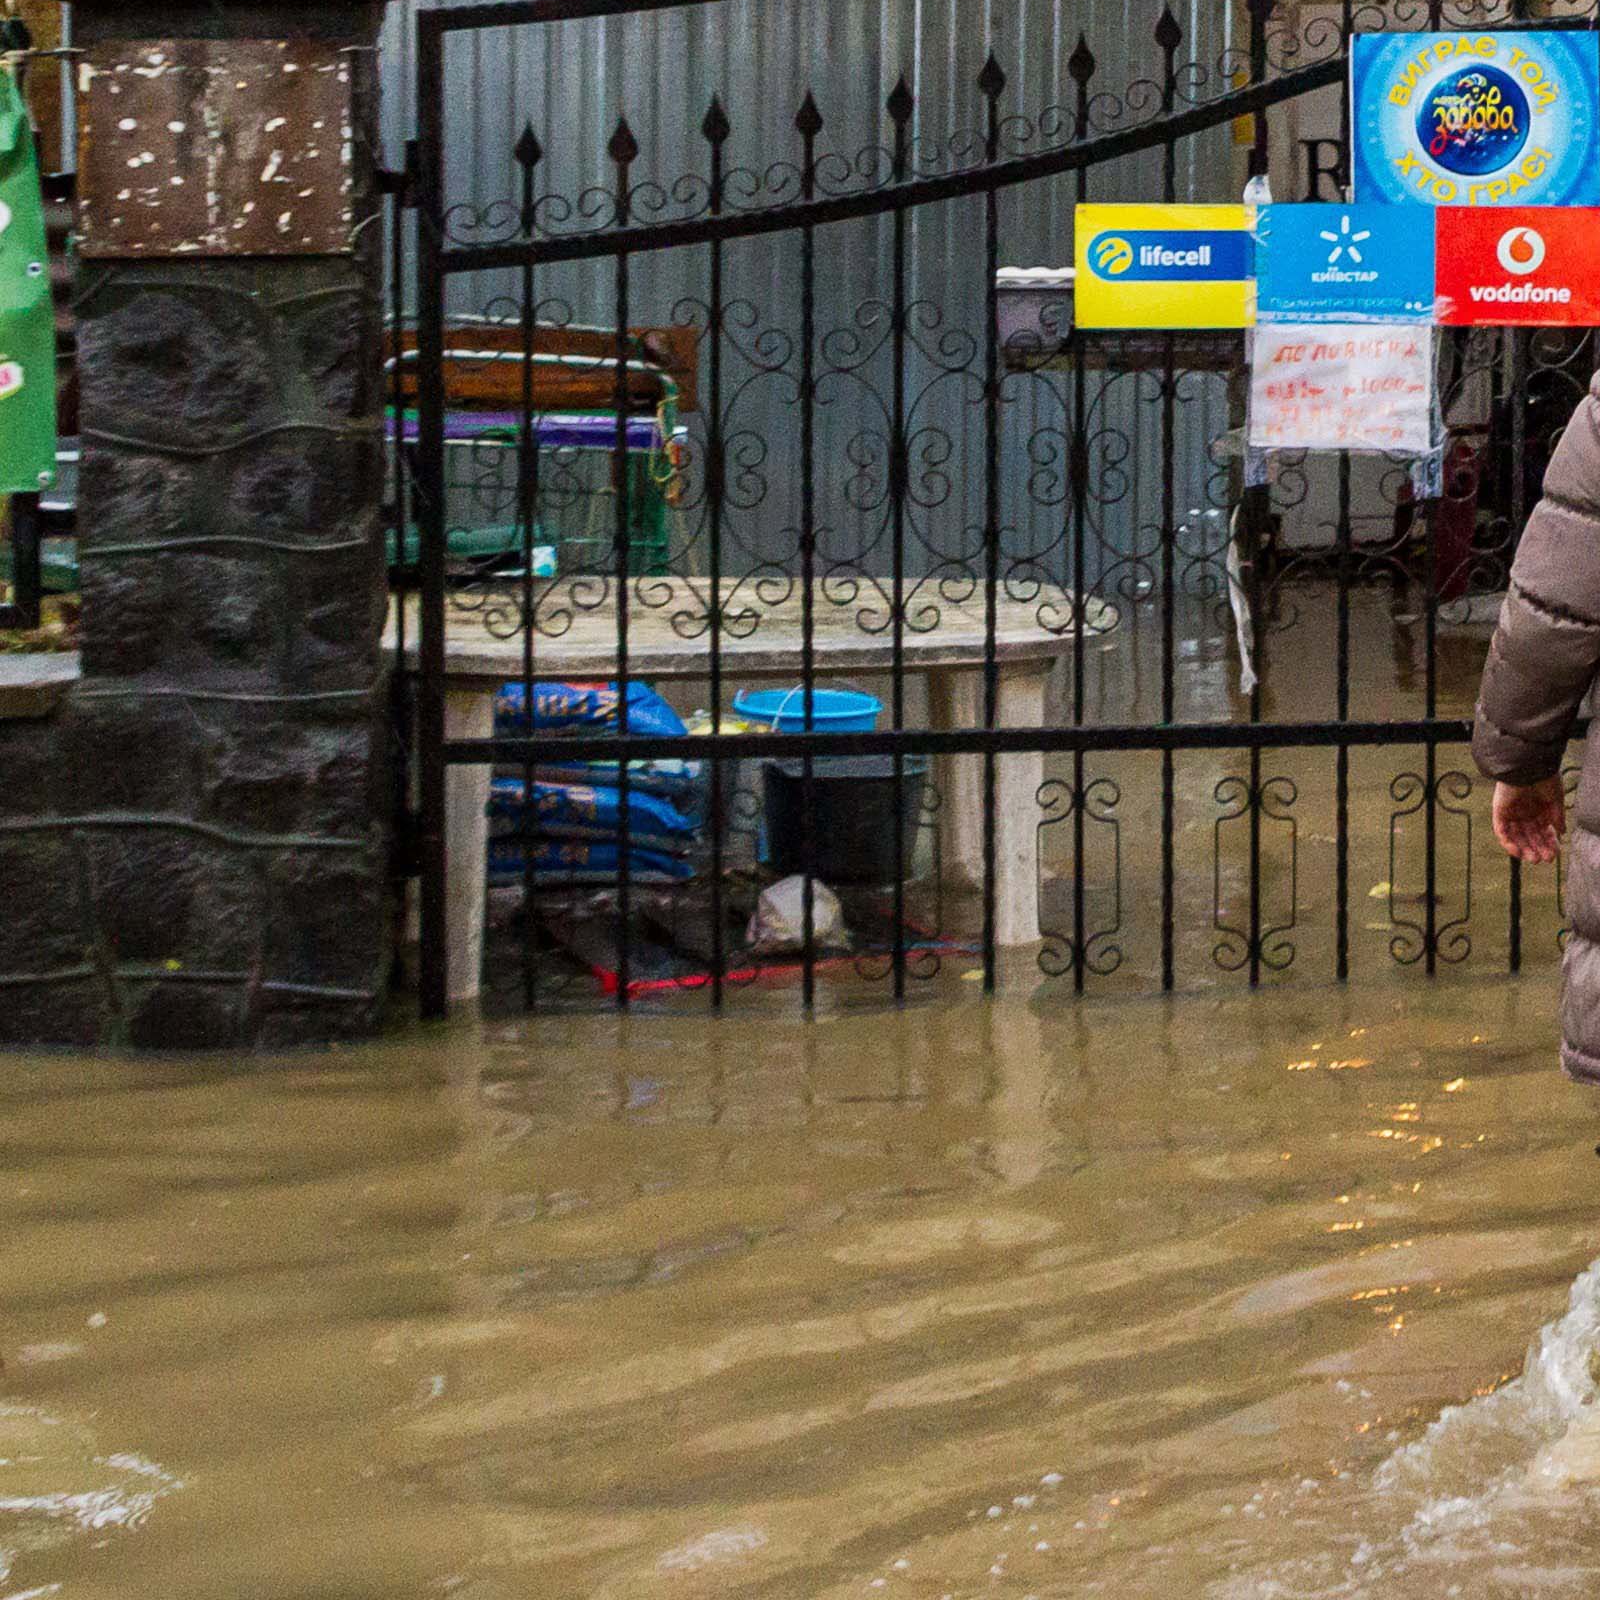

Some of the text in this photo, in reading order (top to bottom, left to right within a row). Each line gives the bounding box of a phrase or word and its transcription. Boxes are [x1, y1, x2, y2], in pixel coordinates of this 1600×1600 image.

[1388, 36, 1561, 115] ВИГРАЄ ТОЙ,
[1394, 149, 1458, 202] ХТО
[1139, 245, 1212, 267] lifecell
[1310, 266, 1379, 283] КИЇВСТАР
[1470, 283, 1572, 304] vodafone
